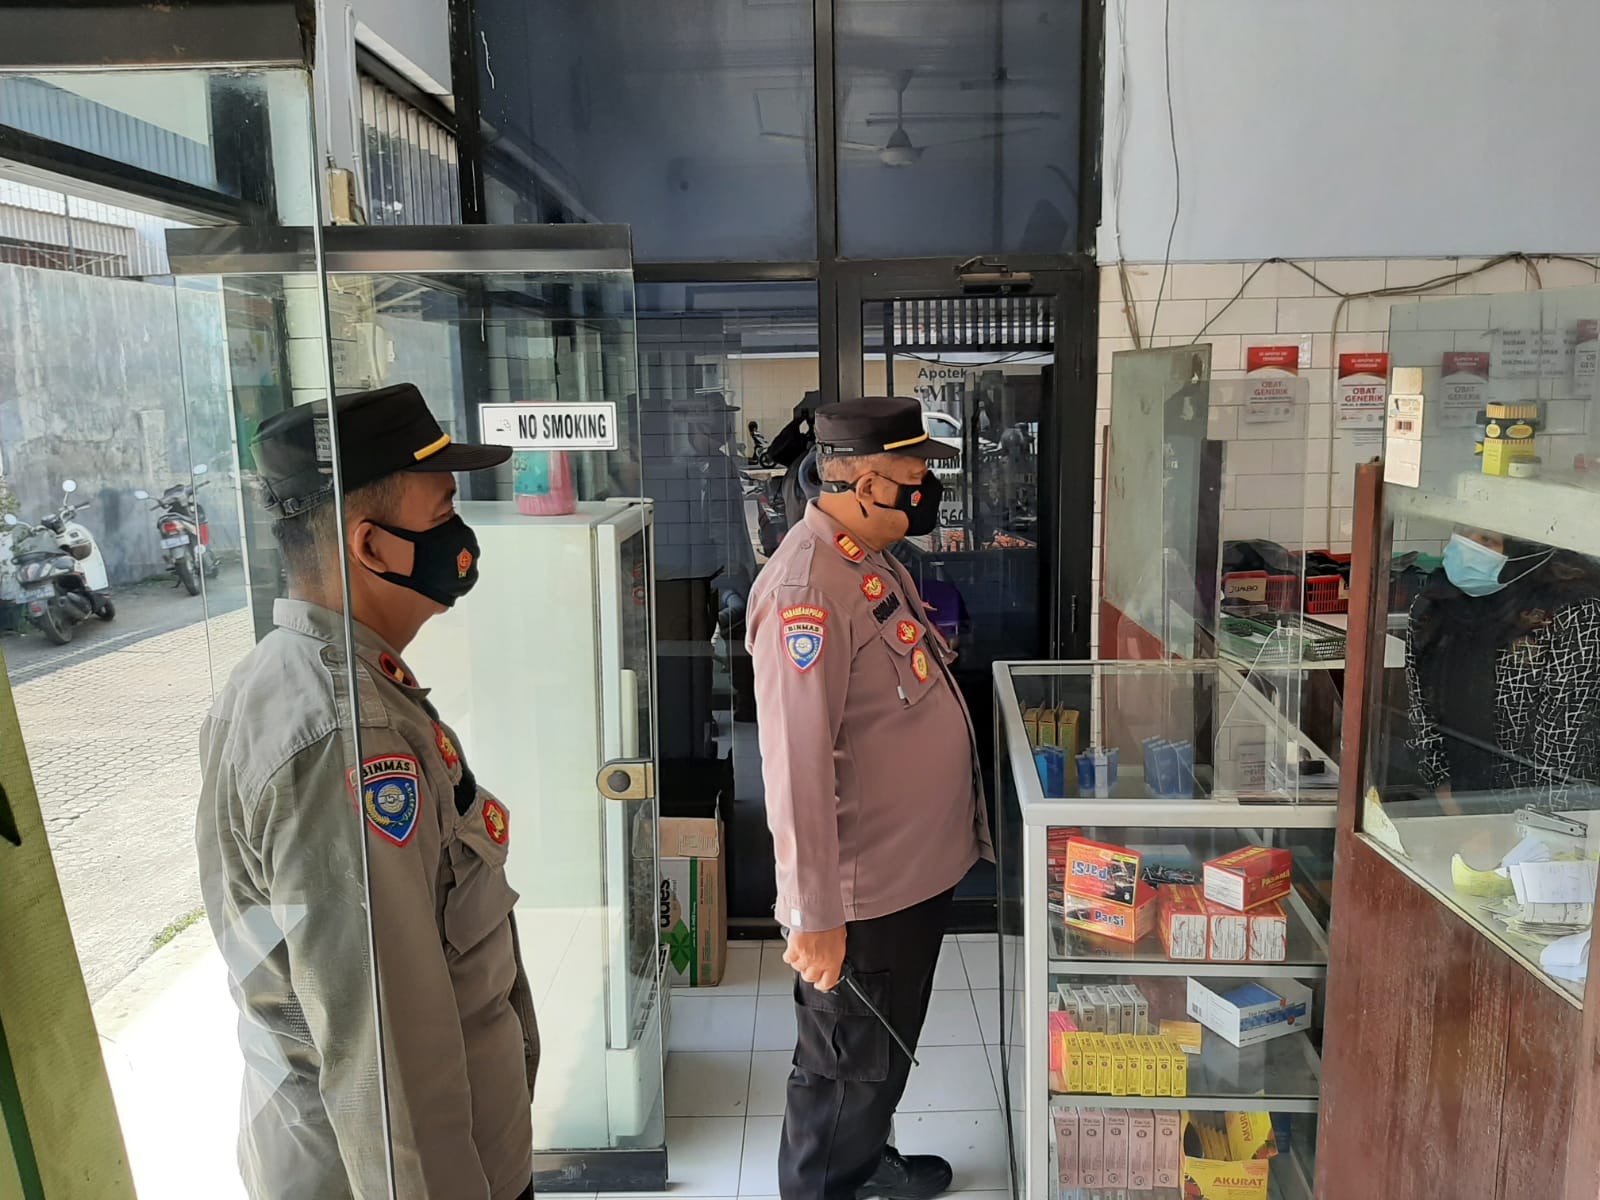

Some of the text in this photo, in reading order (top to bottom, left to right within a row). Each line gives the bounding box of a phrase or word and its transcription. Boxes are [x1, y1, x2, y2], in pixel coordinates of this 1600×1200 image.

[918, 367, 966, 381] Apotek
[1352, 387, 1377, 395] OBAT
[1344, 395, 1384, 403] GENERIK
[518, 414, 607, 439] NO SMOKING
[787, 624, 820, 633] BINMAS
[1212, 1176, 1265, 1187] AKURAT
